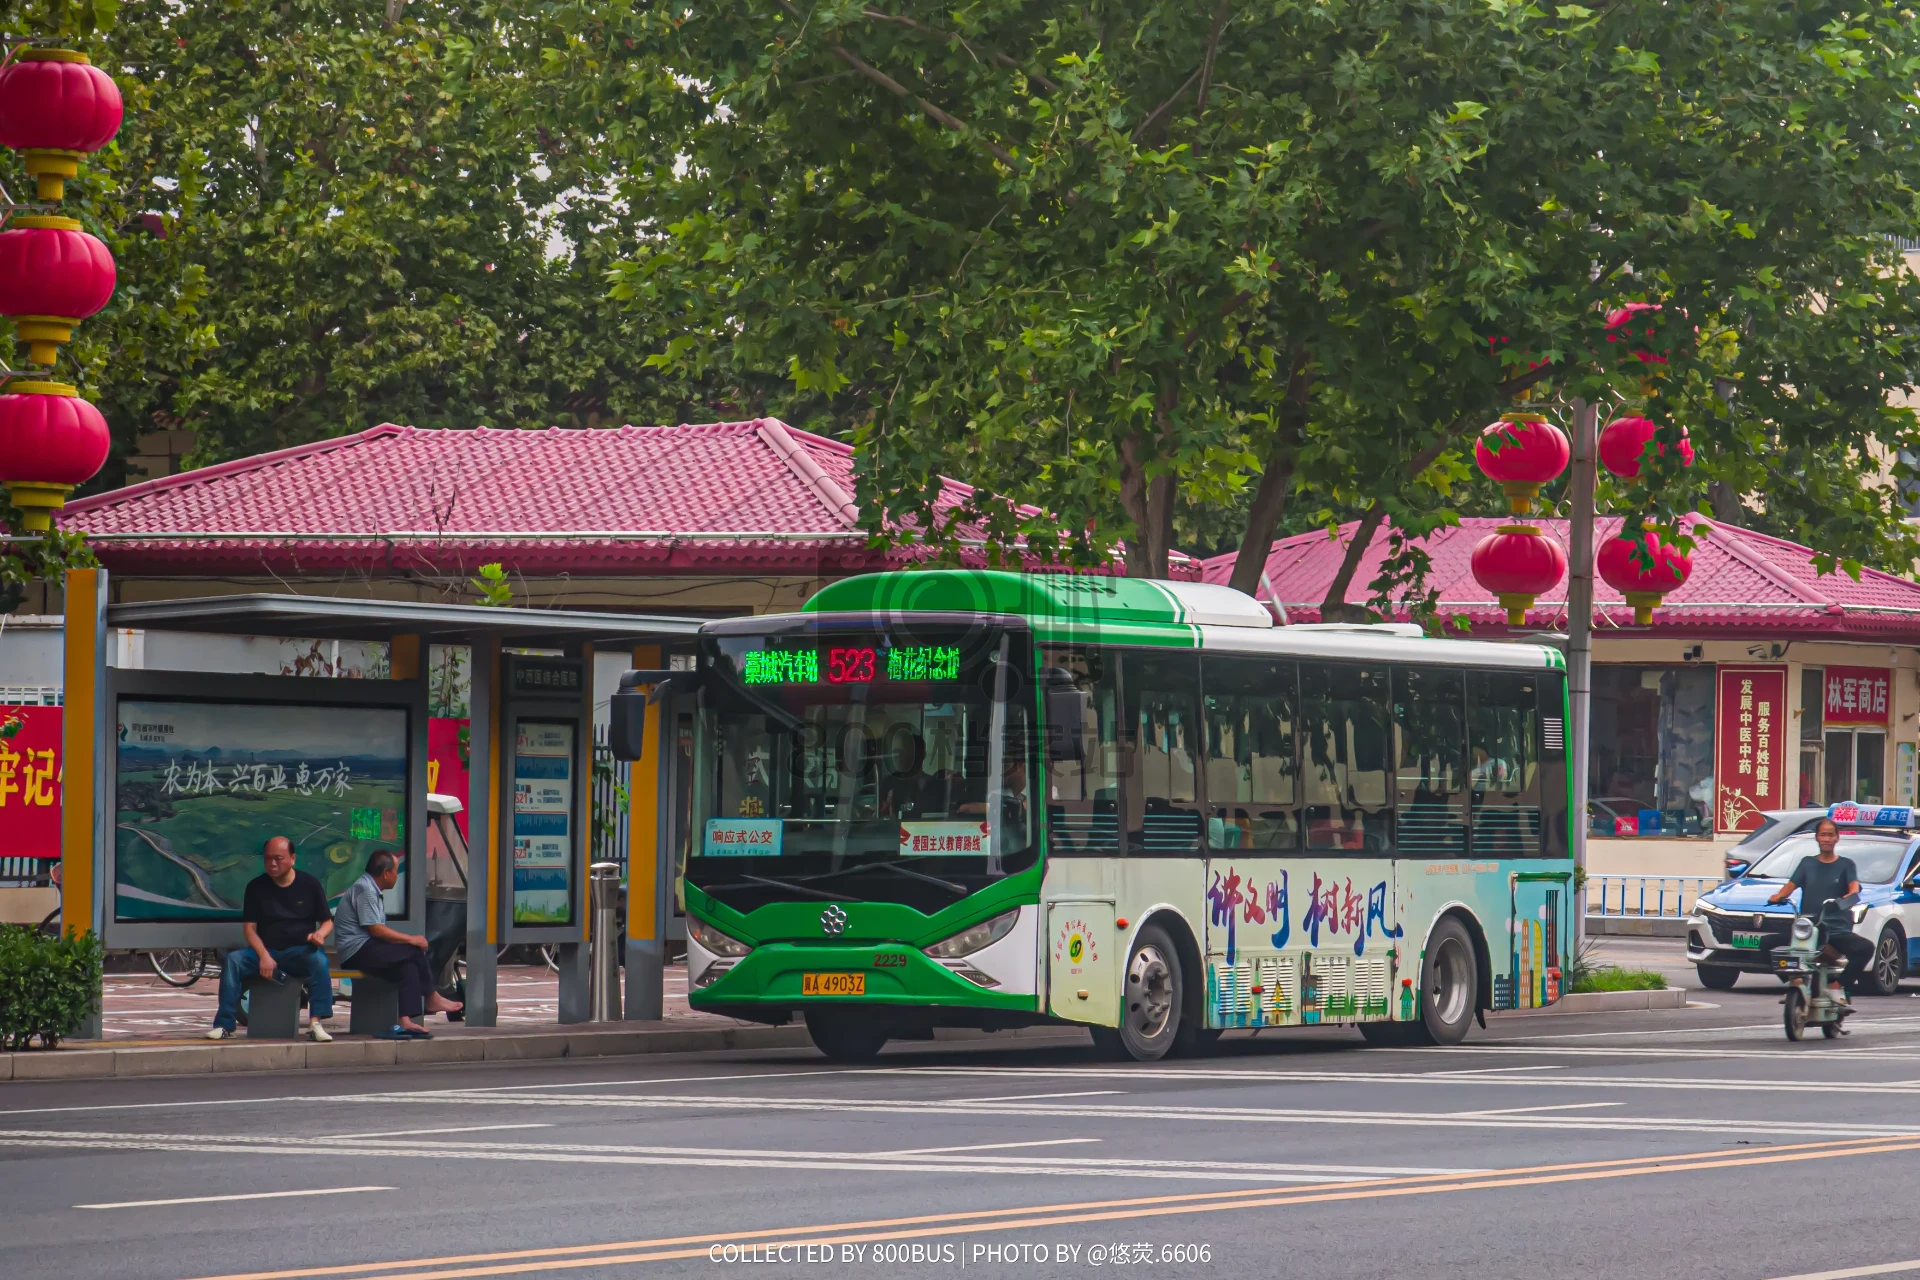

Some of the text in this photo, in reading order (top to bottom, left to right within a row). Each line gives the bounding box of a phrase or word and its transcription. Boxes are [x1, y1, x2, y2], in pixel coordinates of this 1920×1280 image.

[745, 646, 961, 683] 藁城汽车站 523 梅花纪念馆
[1828, 676, 1888, 714] 林军商店
[1738, 679, 1754, 775] 发展中医中药
[1755, 701, 1771, 797] 服务百姓健康
[0, 740, 63, 807] 牢记
[160, 758, 354, 798] 农为本 兴百业 惠万家
[1859, 811, 1878, 821] TAXI
[1879, 810, 1909, 822] 石家庄
[712, 829, 773, 844] 响应式公交
[912, 835, 981, 852] 爱国主义教育路线
[1207, 865, 1405, 967] 讲文明 树新风
[873, 954, 907, 968] 2229
